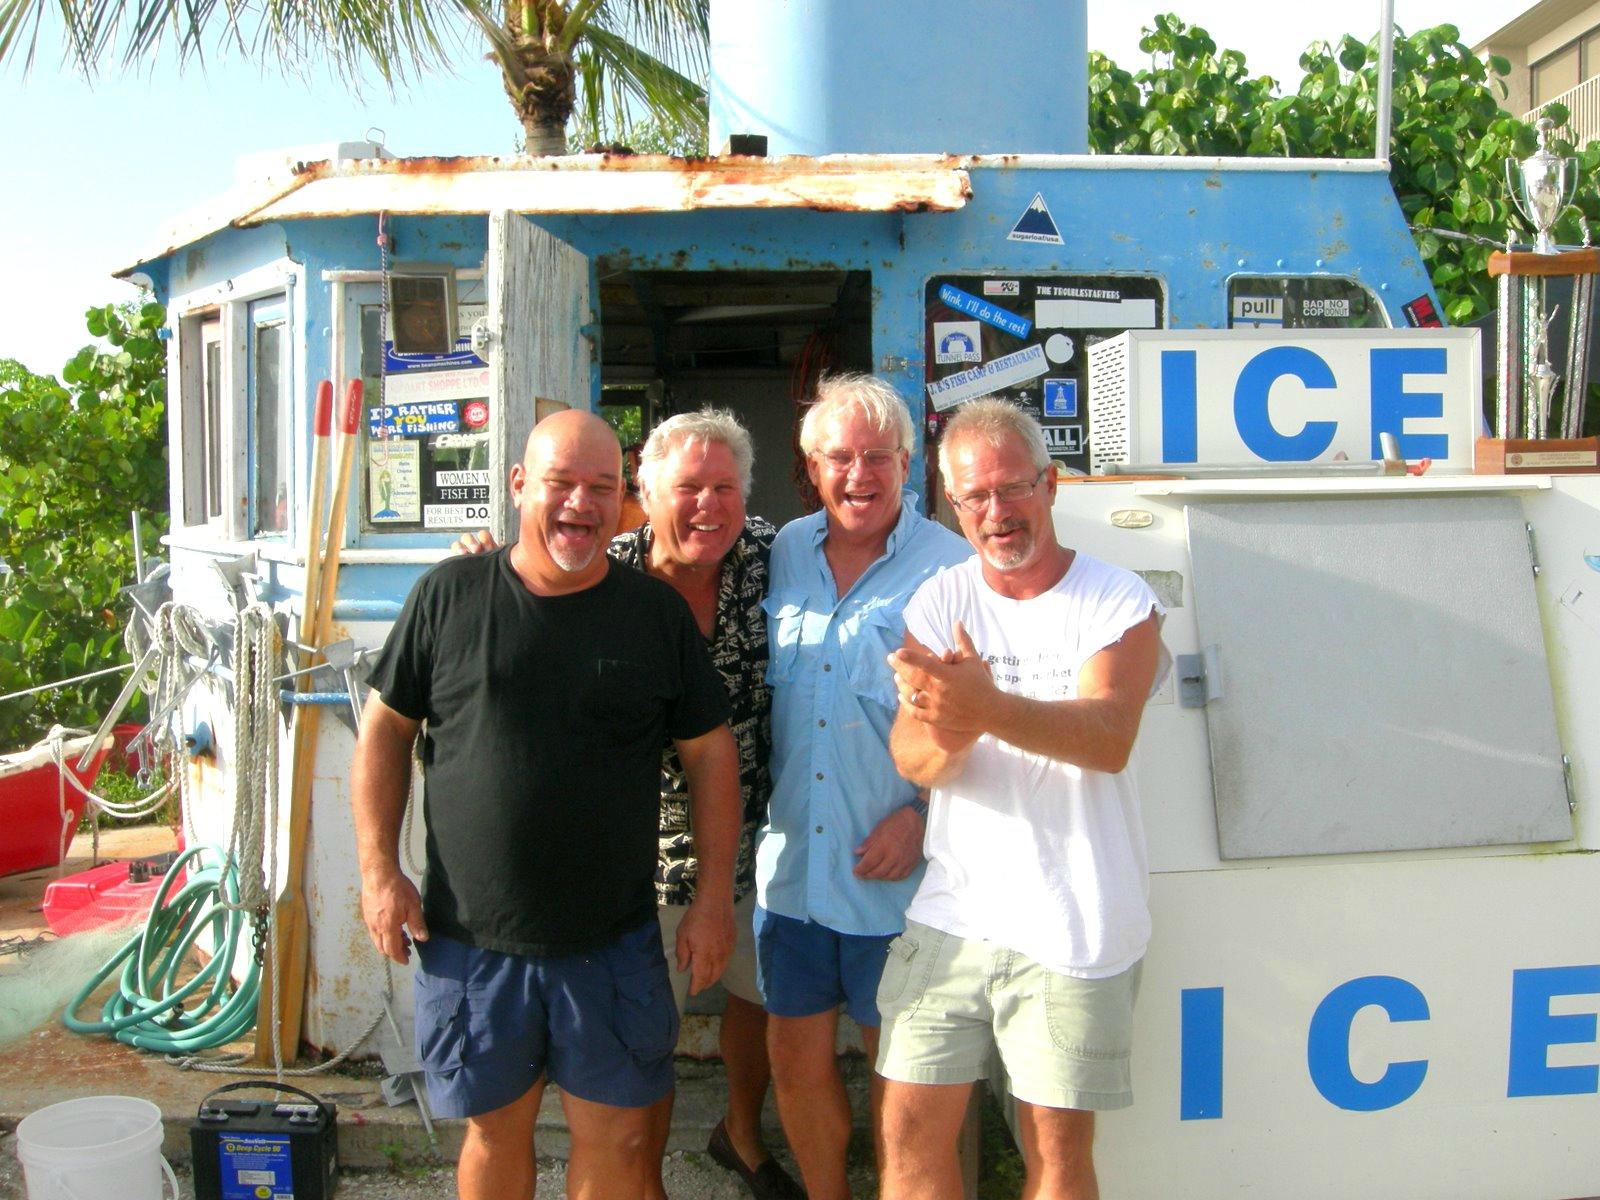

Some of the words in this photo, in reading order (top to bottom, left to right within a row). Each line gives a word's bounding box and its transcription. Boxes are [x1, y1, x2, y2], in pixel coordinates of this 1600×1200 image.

[1036, 285, 1051, 296] THE
[1053, 286, 1120, 300] TROUBLESTARTERS
[1241, 298, 1275, 316] pull
[1302, 300, 1323, 308] BAD
[1328, 300, 1343, 308] NO
[966, 299, 980, 313] I'll
[980, 306, 991, 319] do
[993, 311, 1007, 326] the
[1302, 308, 1323, 317] COP
[1324, 308, 1349, 317] DONUT
[937, 353, 963, 362] TUNNEL
[964, 352, 980, 362] PASS
[950, 373, 968, 388] FISH
[967, 366, 987, 381] CAMP
[988, 365, 995, 375] &
[995, 346, 1041, 373] RESTAURANT
[398, 402, 456, 416] RATHER
[1161, 345, 1448, 463] ICE
[394, 414, 426, 425] YOU
[371, 424, 403, 437] WRE
[407, 421, 457, 433] FISHING
[440, 472, 479, 485] WOMEN
[440, 488, 468, 500] FISH
[472, 487, 490, 499] FE
[426, 507, 441, 515] FOR
[444, 507, 464, 515] BEST
[428, 516, 464, 524] RESULTS
[1180, 964, 1600, 1121] ICE
